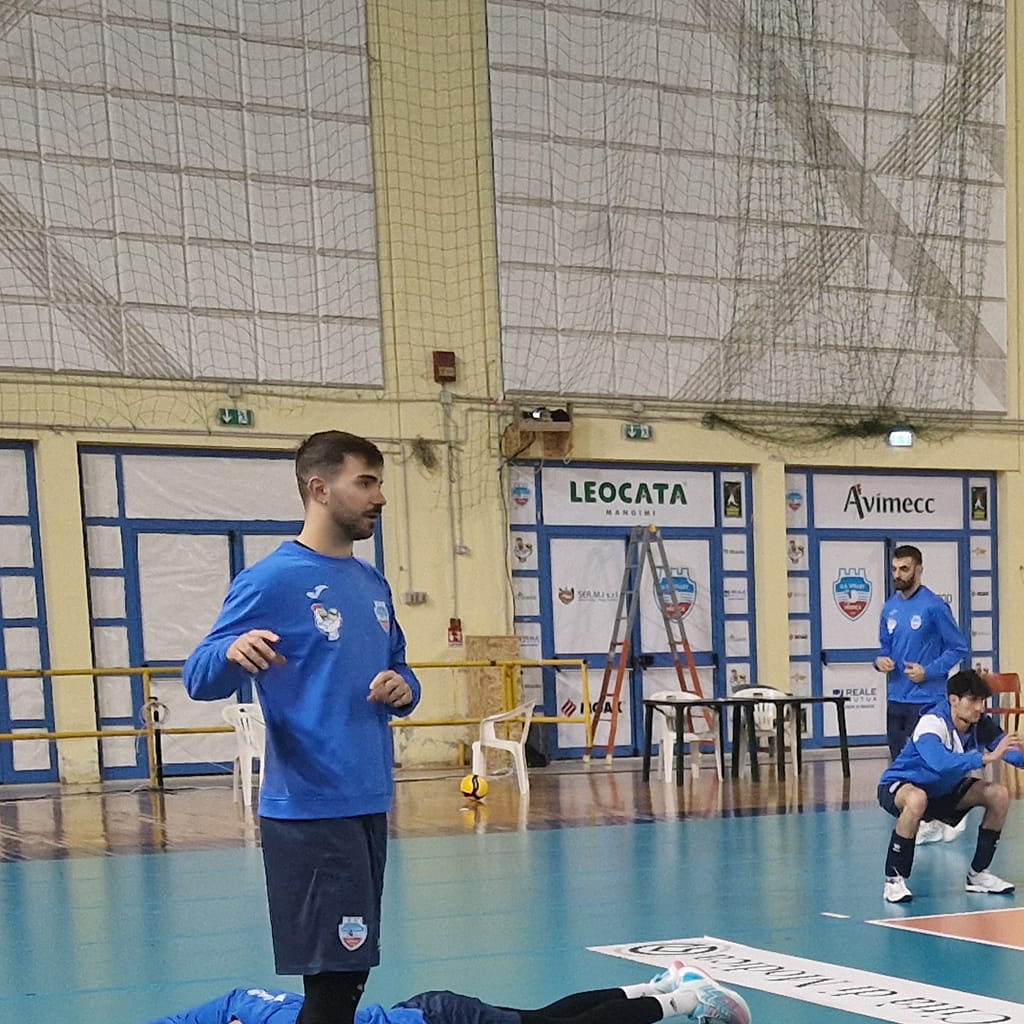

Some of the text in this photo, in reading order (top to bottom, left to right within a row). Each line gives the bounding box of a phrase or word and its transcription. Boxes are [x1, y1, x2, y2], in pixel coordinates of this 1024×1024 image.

[570, 480, 688, 505] LEOCATA
[843, 484, 936, 520] Avimecc
[846, 688, 877, 697] REALE
